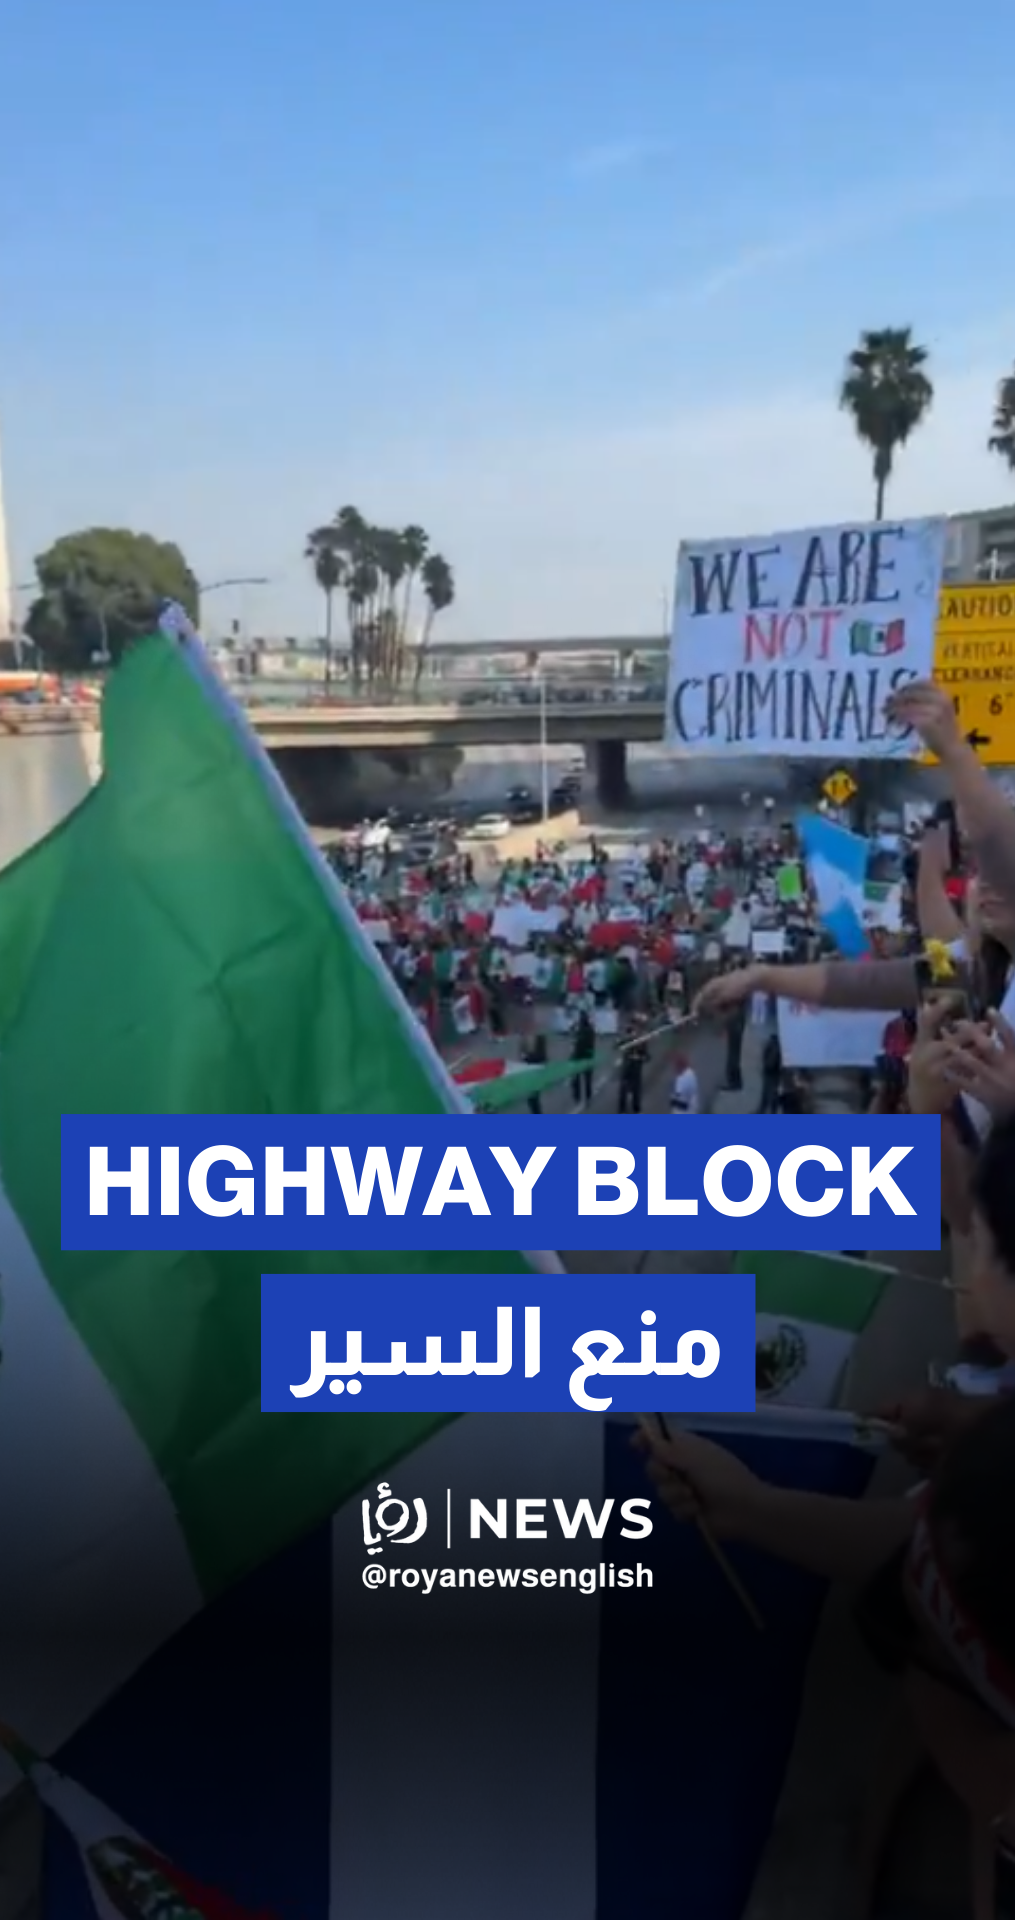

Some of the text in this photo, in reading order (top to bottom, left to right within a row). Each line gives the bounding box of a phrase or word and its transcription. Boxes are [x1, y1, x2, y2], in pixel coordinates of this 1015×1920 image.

[688, 525, 905, 617] WE ARE
[938, 594, 1014, 620] AUTIO
[743, 609, 843, 664] NOT
